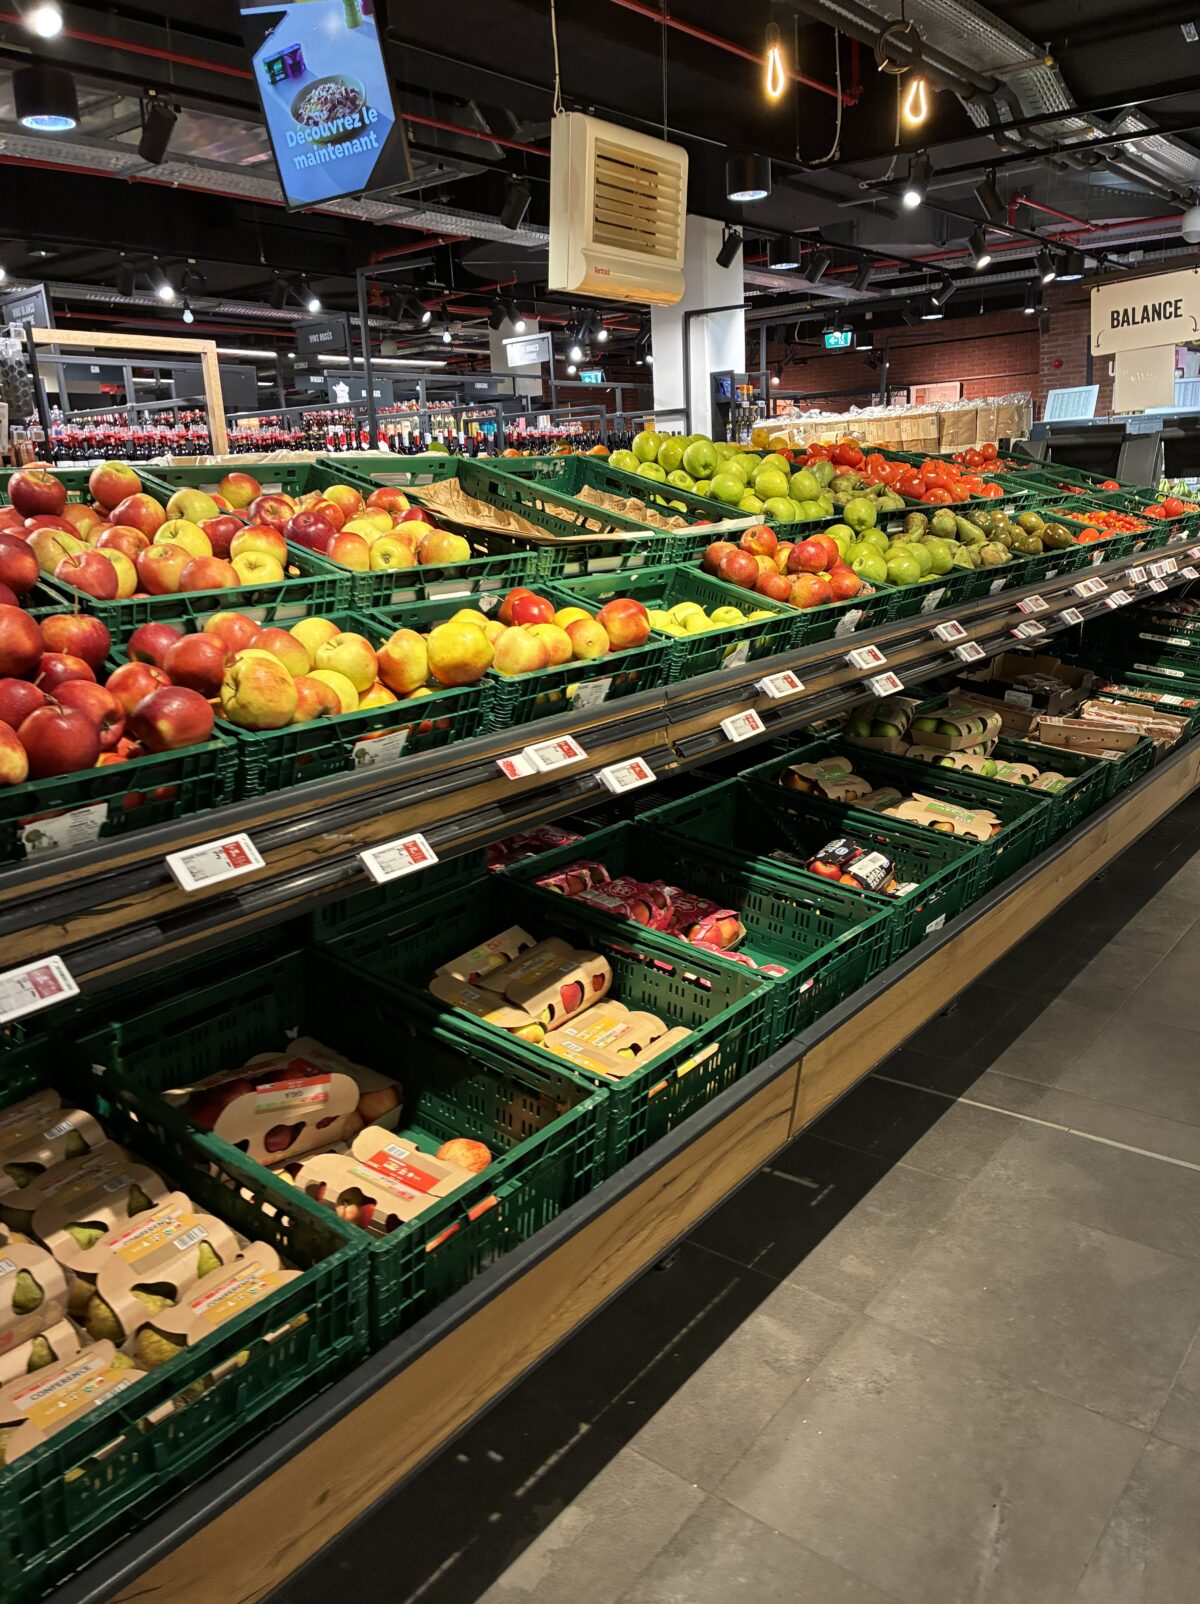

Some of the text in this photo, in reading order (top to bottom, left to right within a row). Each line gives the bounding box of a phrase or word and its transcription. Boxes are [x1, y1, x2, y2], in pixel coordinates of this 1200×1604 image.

[286, 106, 378, 148] Découvrez le
[293, 130, 379, 170] maintenant
[1111, 299, 1183, 329] BALANCE
[30, 1364, 93, 1401] CONFERENCE
